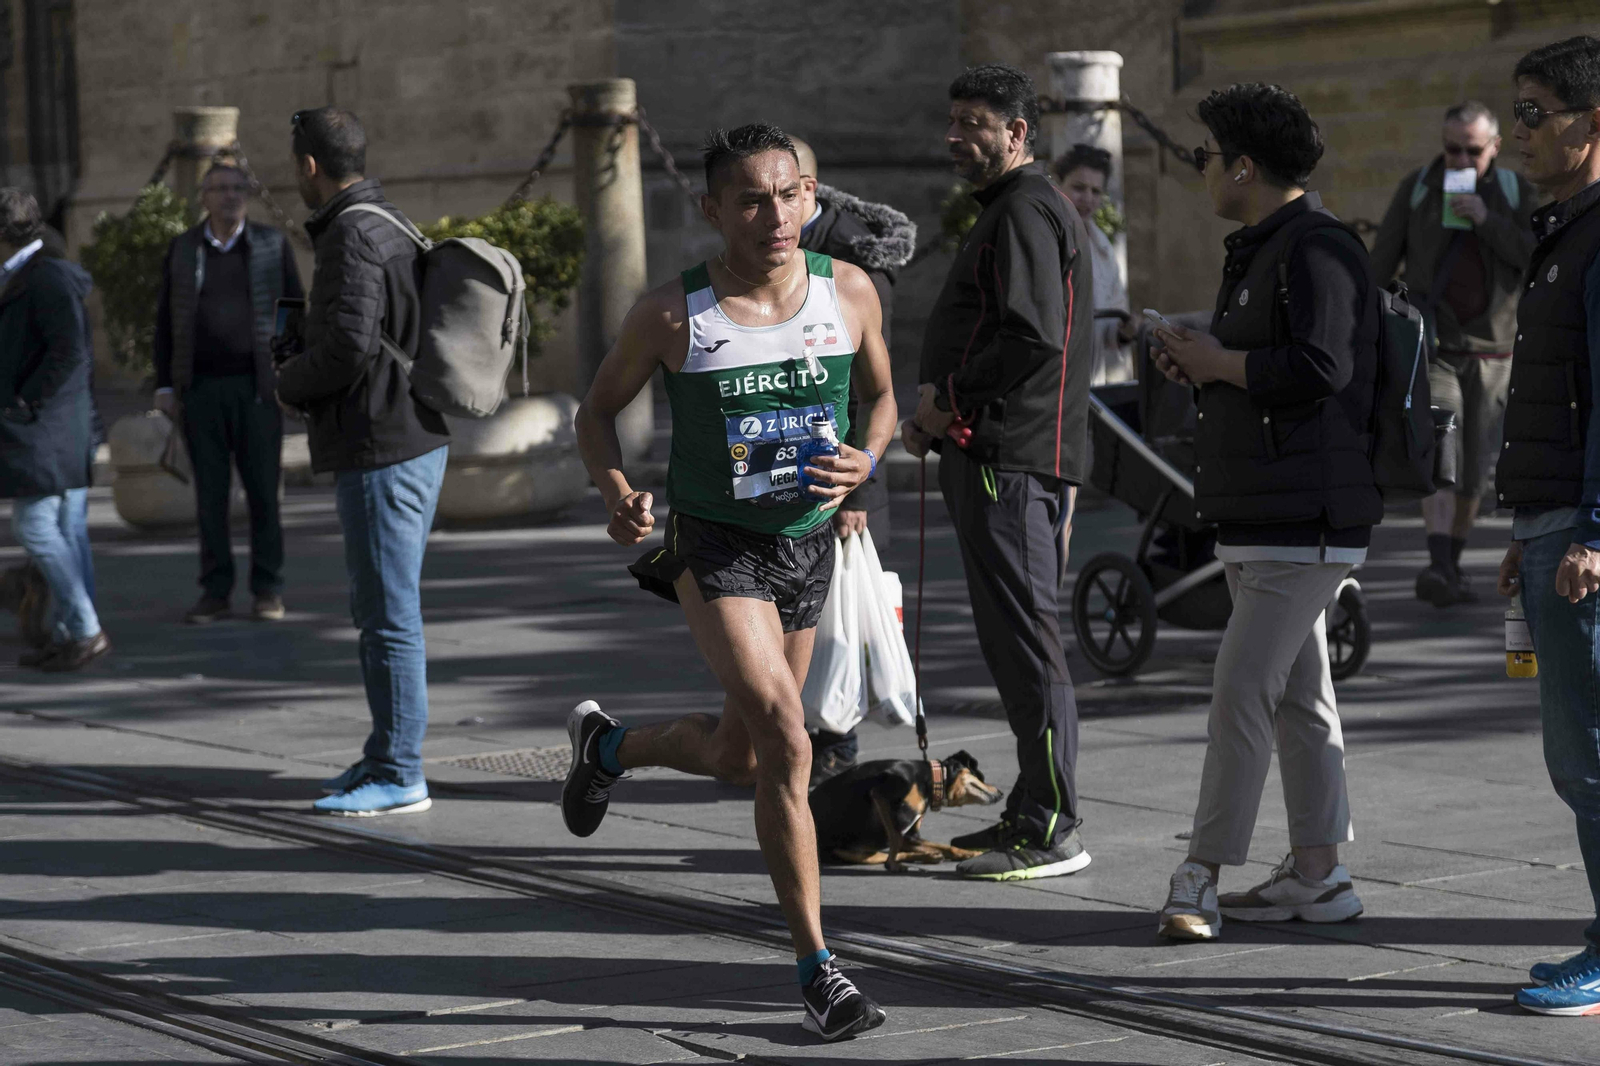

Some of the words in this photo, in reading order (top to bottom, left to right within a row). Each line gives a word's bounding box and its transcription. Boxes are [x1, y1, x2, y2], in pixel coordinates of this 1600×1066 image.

[719, 369, 829, 398] EJÉRCITO
[766, 411, 824, 432] ZURIC
[776, 446, 797, 461] 63
[769, 471, 798, 487] VEGA
